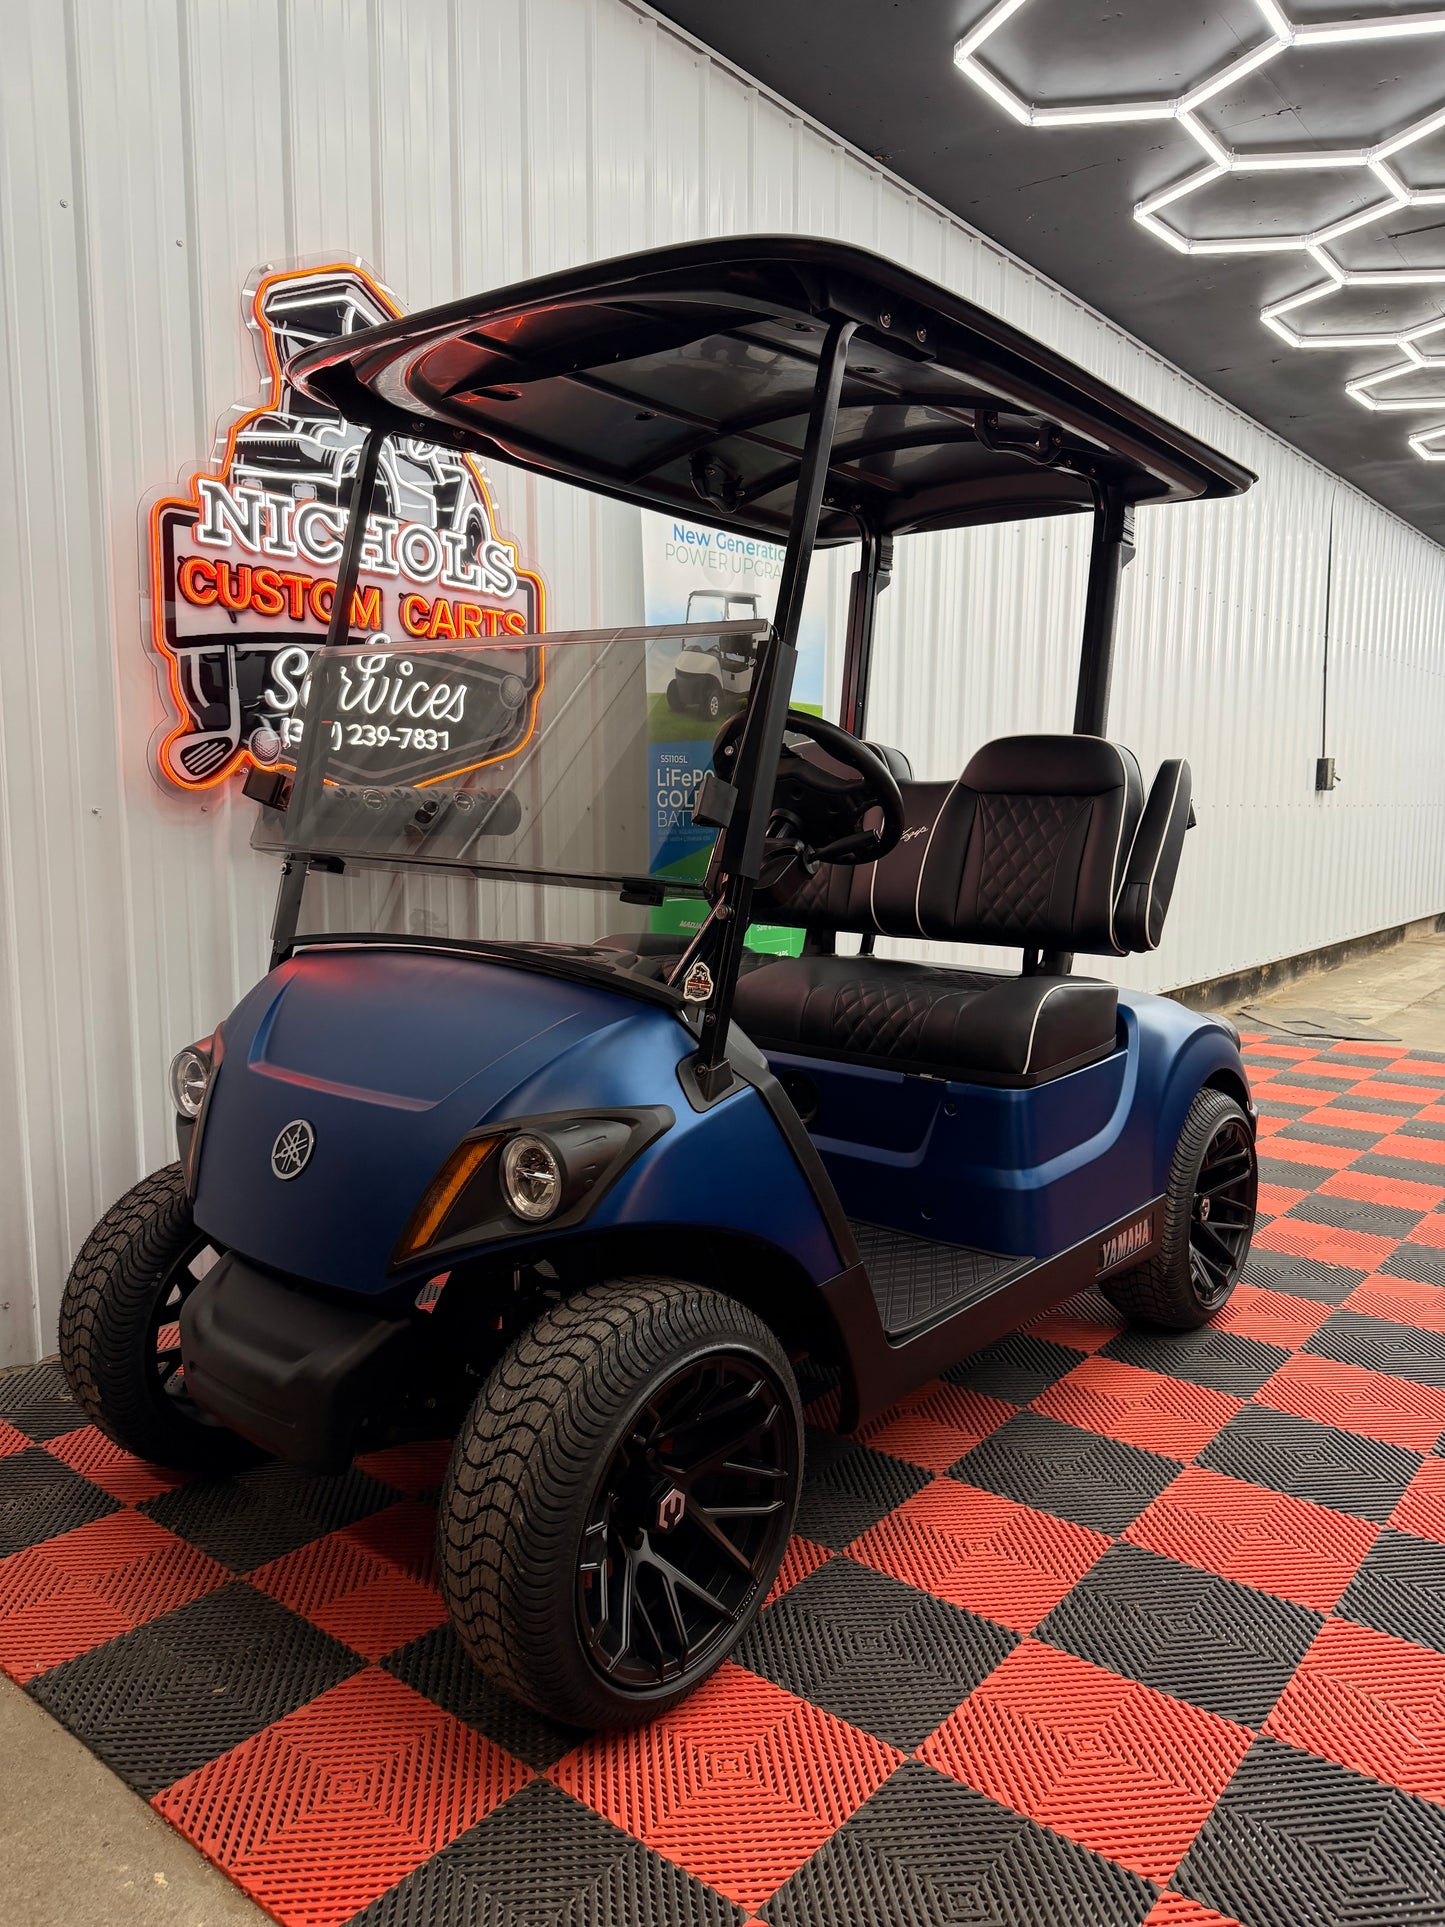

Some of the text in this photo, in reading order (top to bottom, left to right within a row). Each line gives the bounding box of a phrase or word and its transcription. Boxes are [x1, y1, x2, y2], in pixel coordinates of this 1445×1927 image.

[195, 478, 517, 598] NICHOLS
[665, 543, 782, 580] POWER UPGRA
[672, 523, 786, 562] New Generatio
[179, 554, 527, 640] CUSTOM CARTS
[263, 646, 469, 723] Srvices
[345, 724, 450, 751] 239-7831
[1102, 1219, 1149, 1269] YAMAHA
